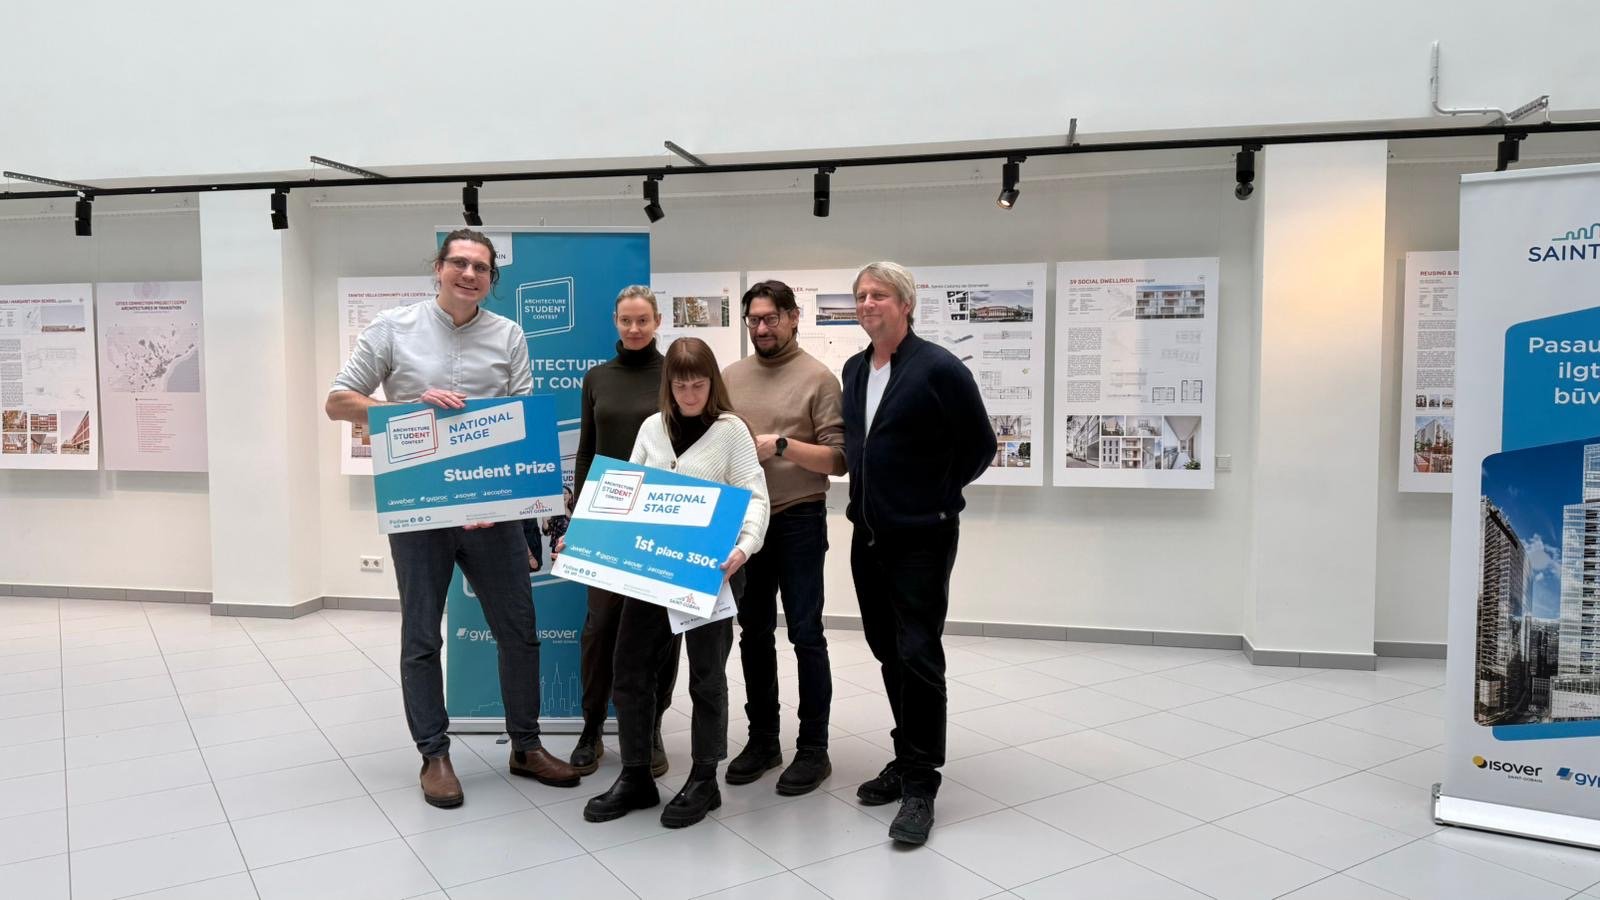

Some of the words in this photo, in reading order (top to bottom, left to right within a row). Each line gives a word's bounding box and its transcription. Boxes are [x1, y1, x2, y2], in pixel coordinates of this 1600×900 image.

[1529, 337, 1600, 353] Pasau
[1559, 362, 1600, 382] ilgt
[1554, 387, 1600, 405] būv
[449, 412, 513, 434] NATIONAL
[393, 431, 430, 440] STUDENT
[449, 428, 490, 446] STAGE
[444, 466, 512, 482] Student
[515, 461, 556, 476] Prize
[602, 486, 632, 497] STUDENT
[604, 480, 634, 492] ARCHITECTURE
[425, 495, 448, 503] gyproc
[486, 488, 512, 496] ecophon
[647, 491, 707, 505] NATIONAL
[643, 503, 681, 515] STAGE
[635, 535, 655, 552] 1st
[655, 546, 684, 561] place
[685, 551, 718, 569] 350€
[563, 563, 579, 572] Follow
[1489, 760, 1543, 776] isover
